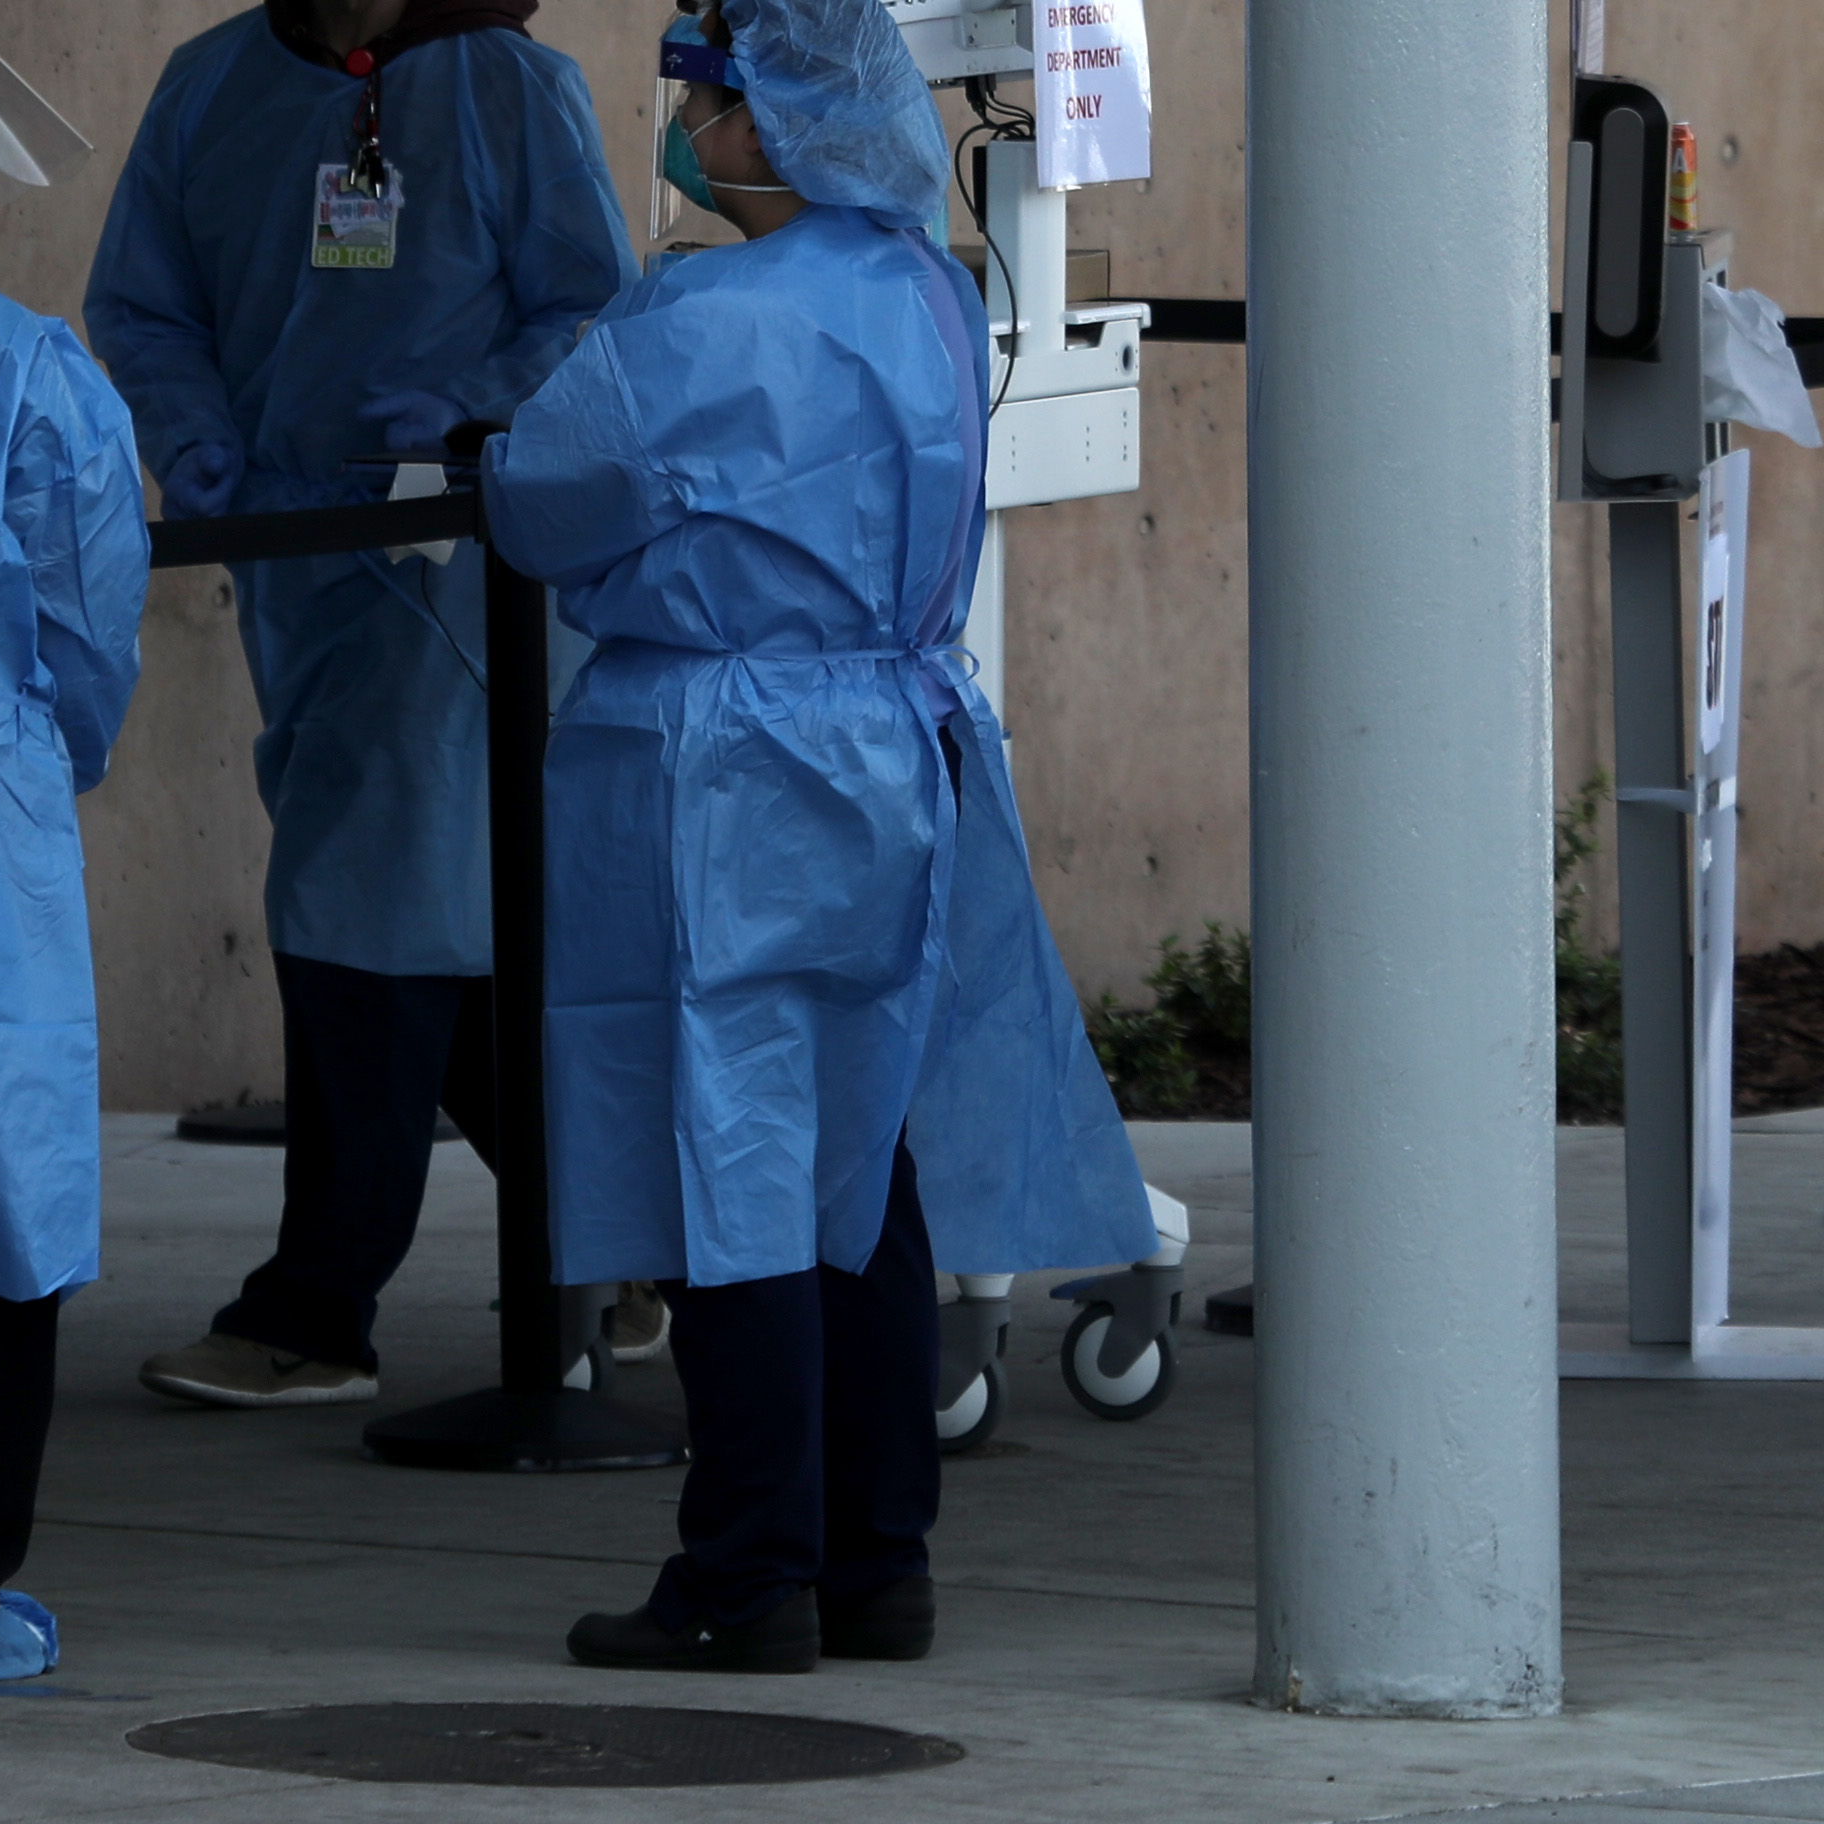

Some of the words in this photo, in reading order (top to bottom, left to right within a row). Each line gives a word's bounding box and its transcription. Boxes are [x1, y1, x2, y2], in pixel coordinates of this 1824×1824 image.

[1047, 2, 1115, 28] EMERGENCY
[1047, 47, 1123, 72] DEPARTMENT
[1066, 95, 1103, 120] ONLY
[318, 248, 341, 265] ED
[346, 248, 389, 265] TECH
